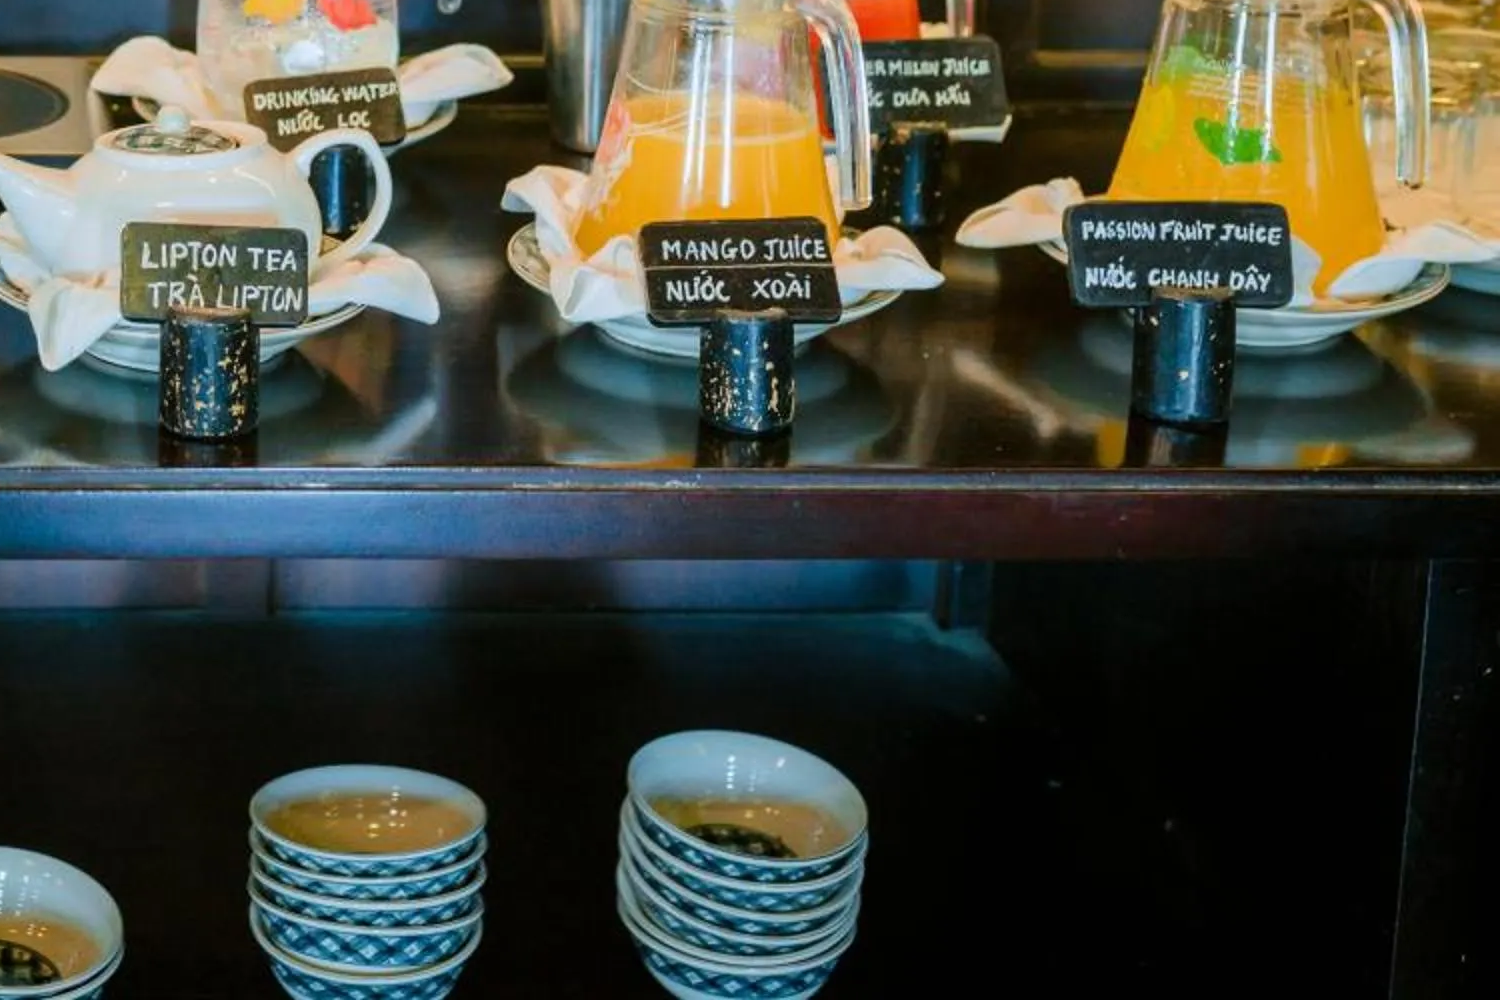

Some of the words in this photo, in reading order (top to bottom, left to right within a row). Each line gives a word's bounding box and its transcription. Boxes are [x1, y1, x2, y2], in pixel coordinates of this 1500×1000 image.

[942, 56, 991, 78] JUICE
[253, 86, 340, 111] DRINKING
[341, 81, 399, 103] WATER
[1081, 219, 1156, 242] PASSION
[1159, 219, 1216, 242] FRUIT
[1219, 221, 1284, 246] JUICE
[140, 240, 238, 271] LIPTON
[248, 246, 298, 273] TEA
[661, 237, 756, 262] MANGO
[763, 233, 828, 261] JUICE
[752, 271, 813, 300] XOÀI
[1147, 267, 1220, 290] CHANH
[1229, 263, 1272, 294] DÂY
[148, 274, 205, 309] TRÀ
[215, 285, 303, 313] LIPTON
